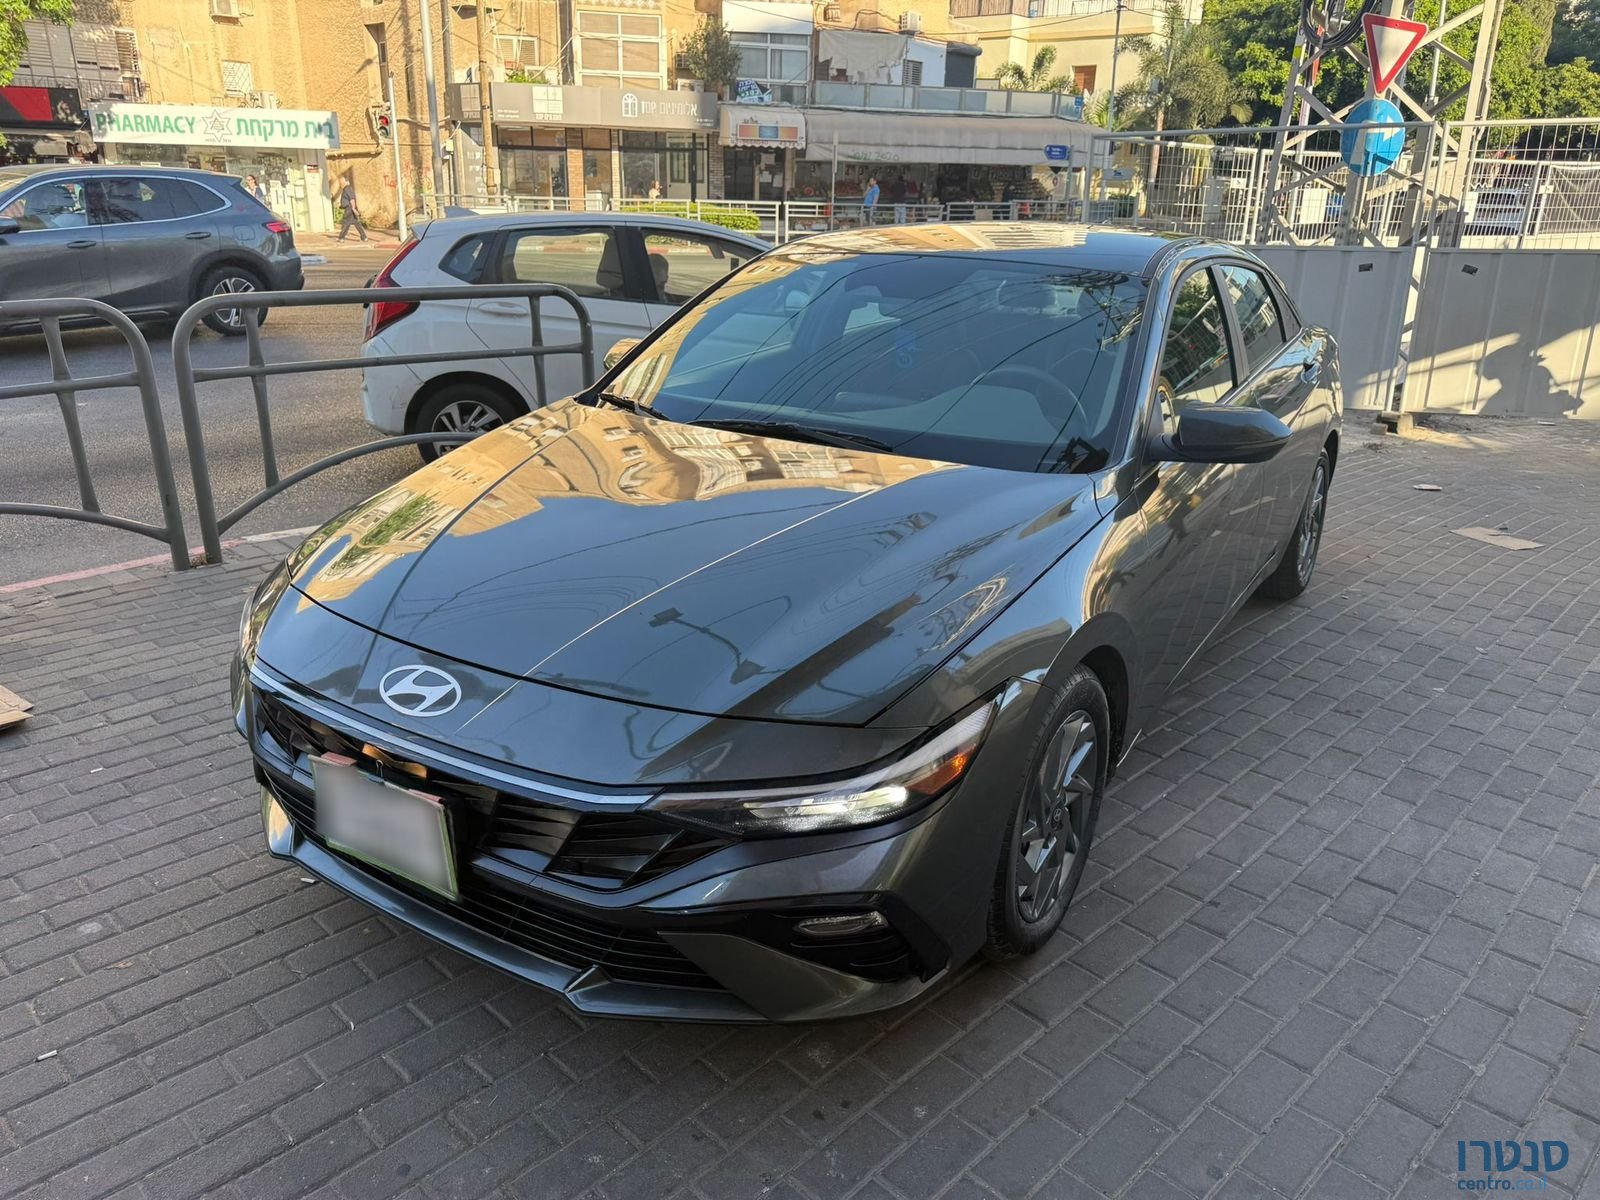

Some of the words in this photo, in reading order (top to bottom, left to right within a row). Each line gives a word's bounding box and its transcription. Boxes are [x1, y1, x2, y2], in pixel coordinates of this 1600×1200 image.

[95, 112, 196, 134] PHARMACY
[236, 117, 299, 142] מרקחת
[304, 120, 335, 139] בית
